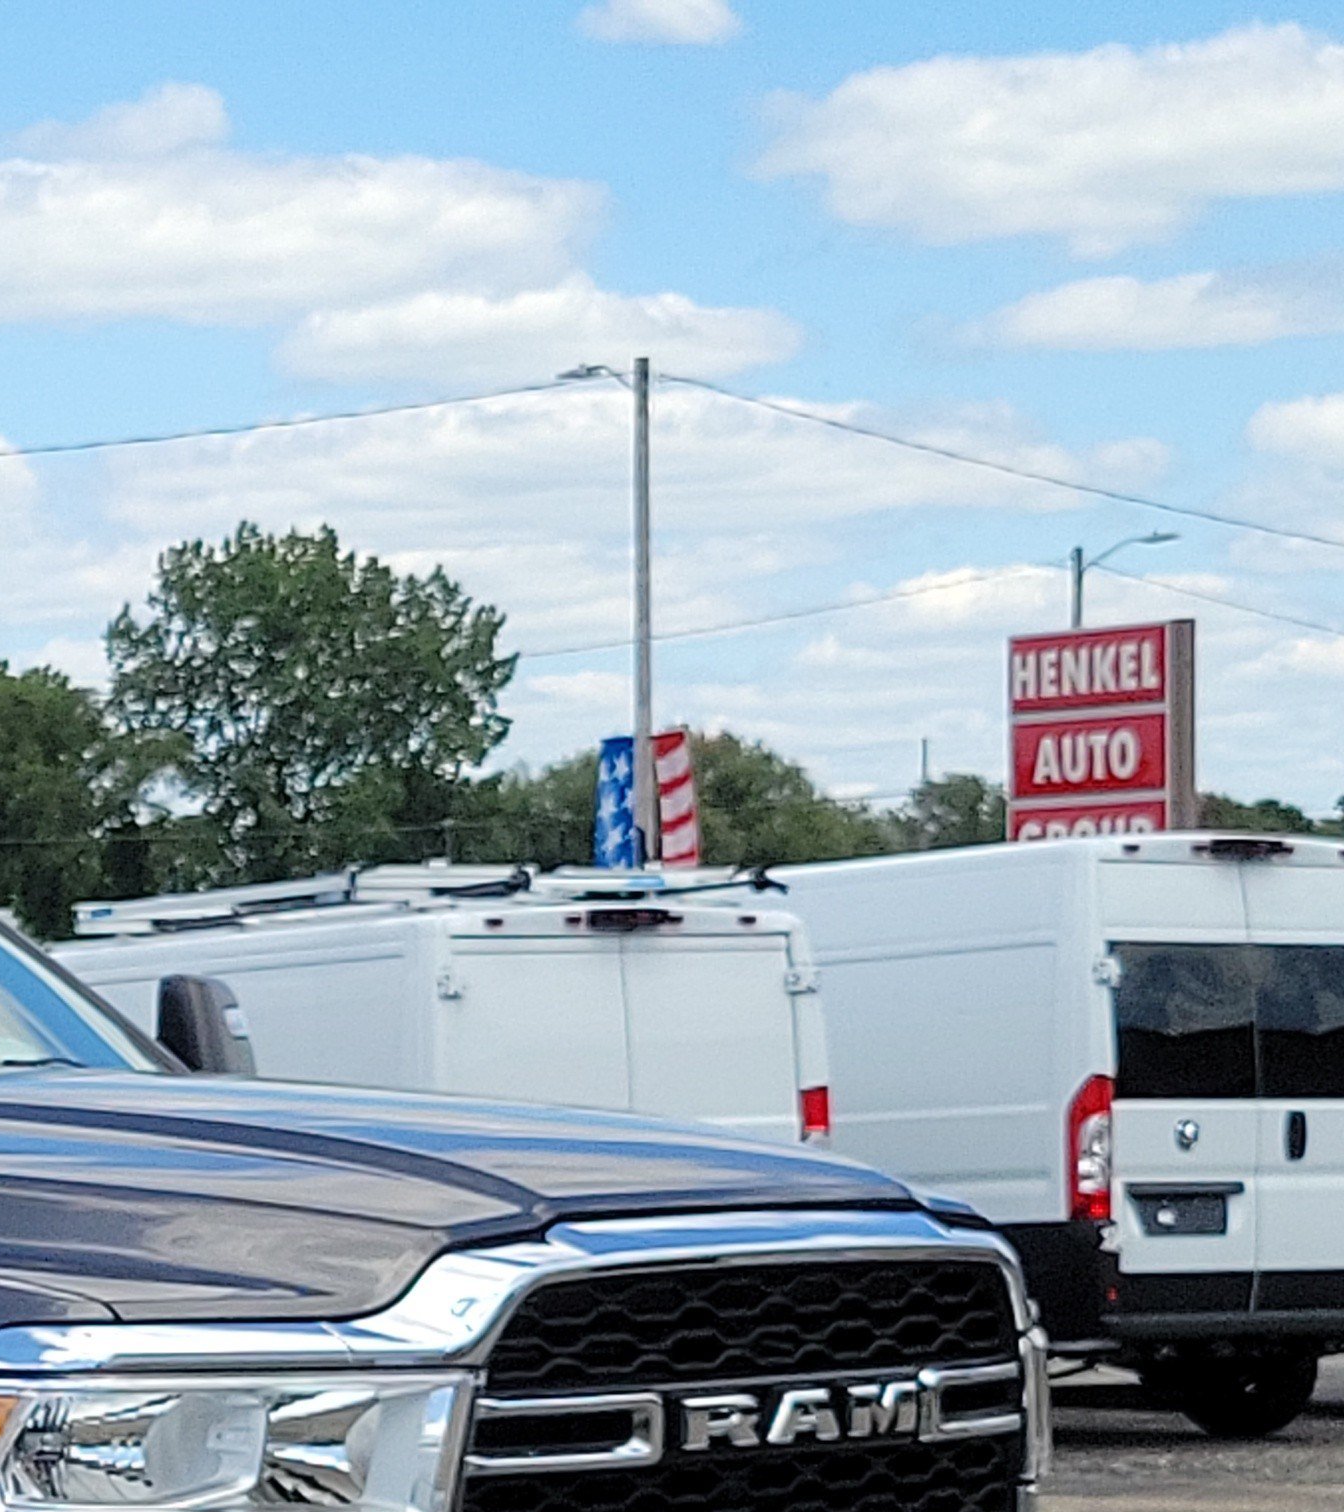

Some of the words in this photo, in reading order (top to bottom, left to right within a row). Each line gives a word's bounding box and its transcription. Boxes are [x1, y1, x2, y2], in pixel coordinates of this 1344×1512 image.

[1013, 640, 1159, 700] HENKEL
[1033, 728, 1138, 785] AUTO
[681, 1381, 920, 1452] RAM
